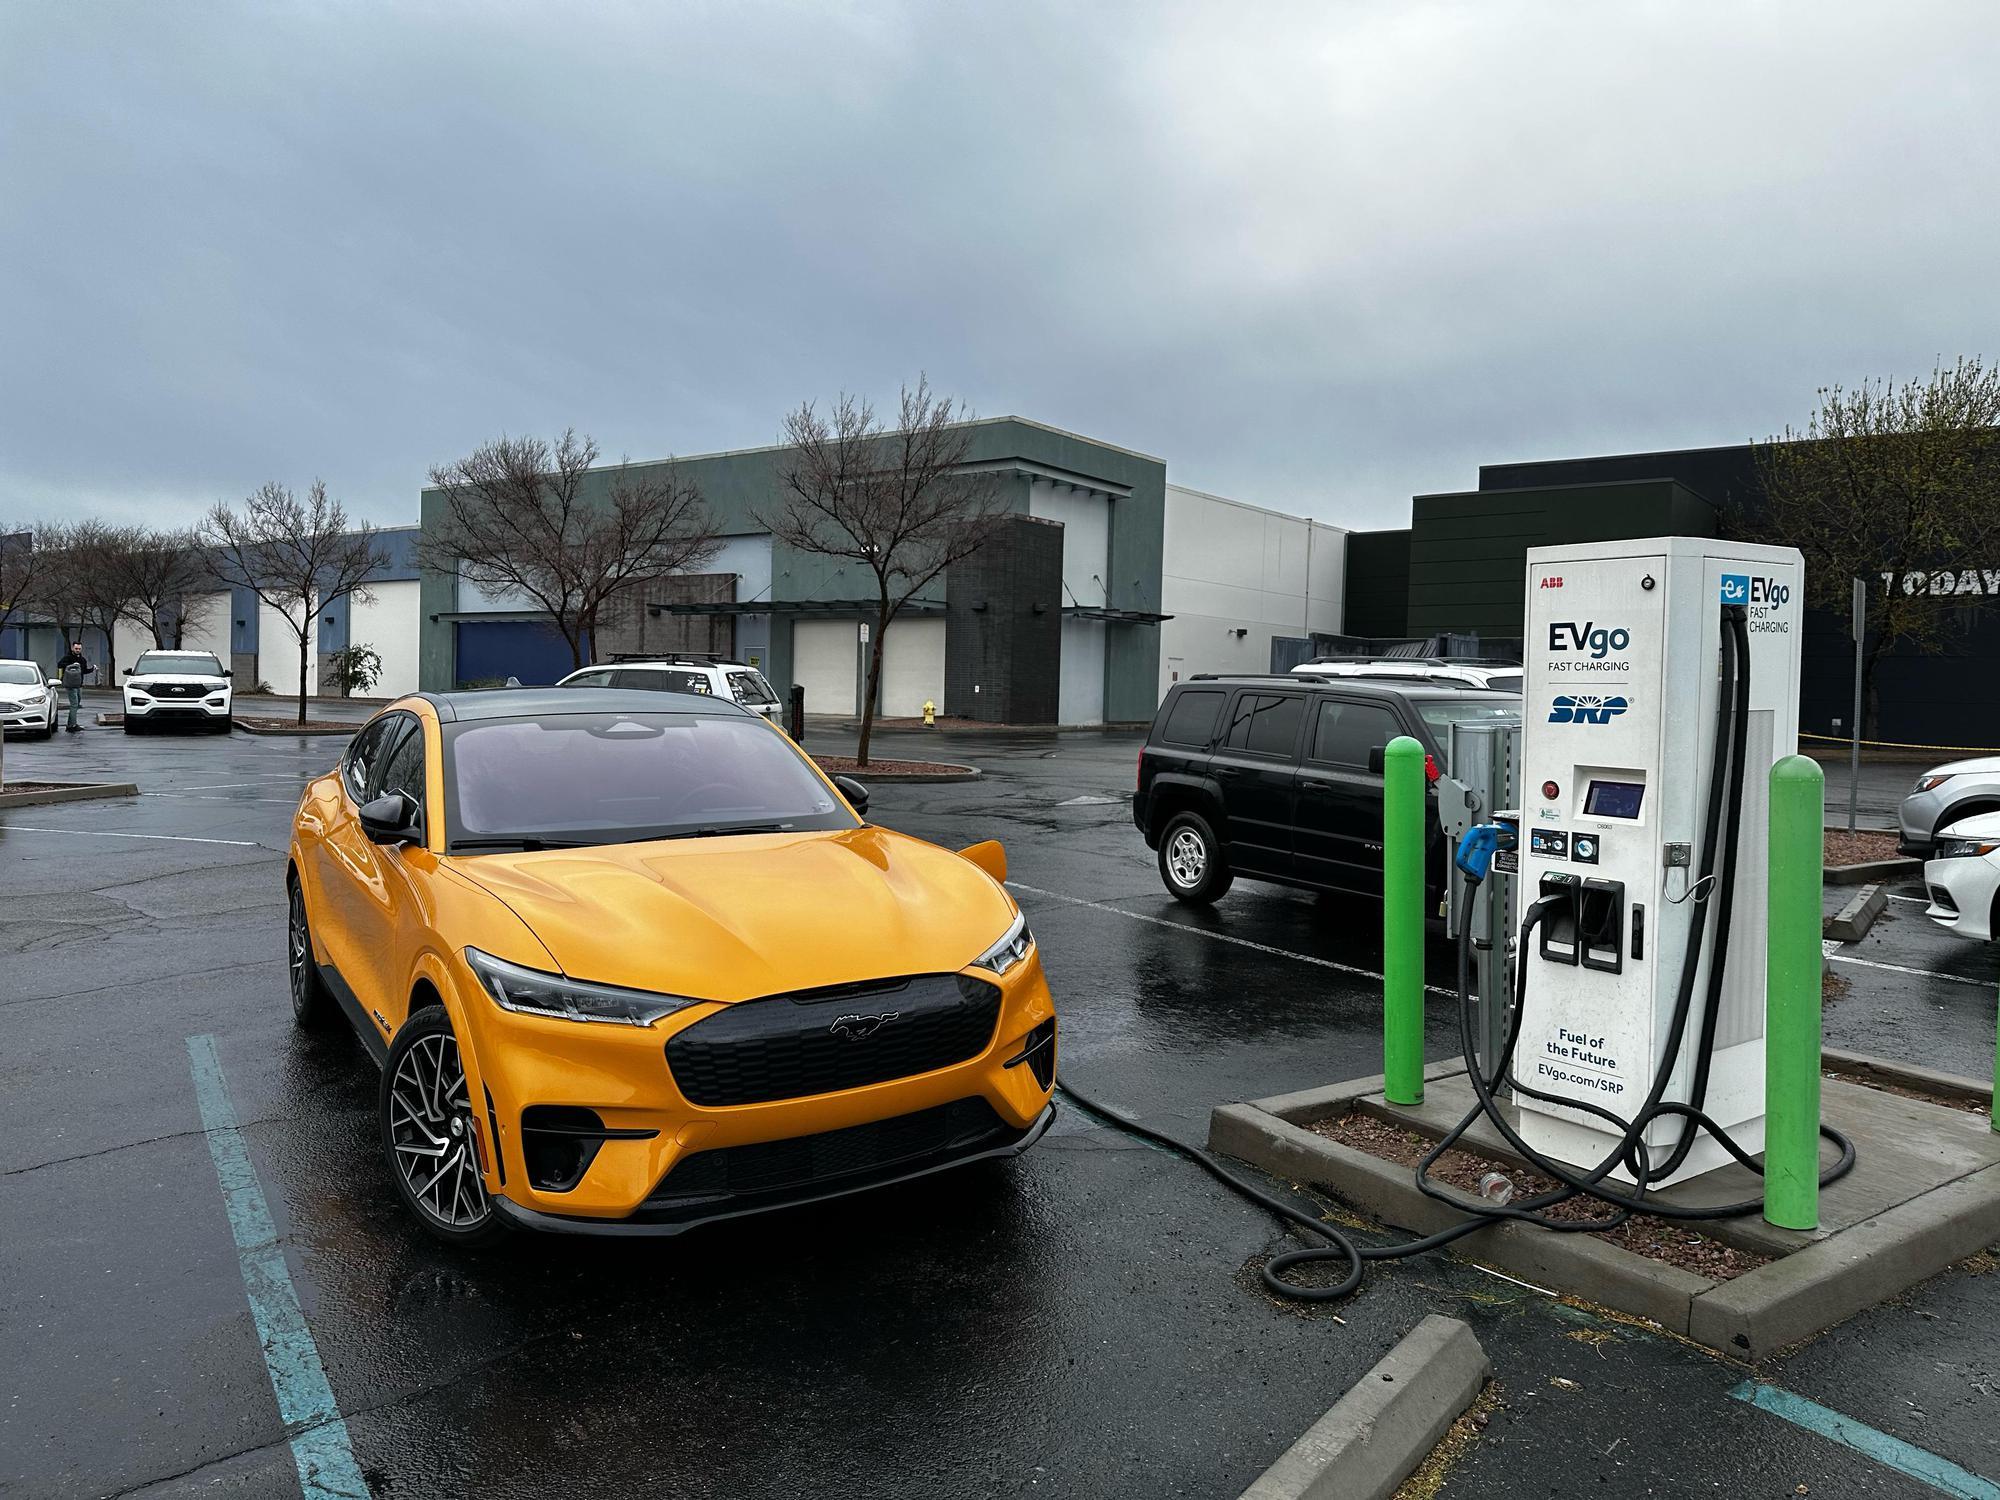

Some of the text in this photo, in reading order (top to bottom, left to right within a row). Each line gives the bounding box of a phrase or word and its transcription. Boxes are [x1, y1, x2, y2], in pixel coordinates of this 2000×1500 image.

[1540, 577, 1564, 589] ABB
[1750, 576, 1790, 611] EVgo
[1749, 606, 1769, 619] FAST
[1749, 620, 1789, 633] CHARGING
[1549, 621, 1630, 659] EVgo
[1548, 661, 1630, 672] FAST CHARGING
[1548, 695, 1629, 724] SRP
[1364, 843, 1383, 851] PAT
[1560, 1028, 1605, 1049] Fuel of
[1547, 1042, 1616, 1069] the Future
[1538, 1064, 1624, 1095] EVgo.com/SRP
